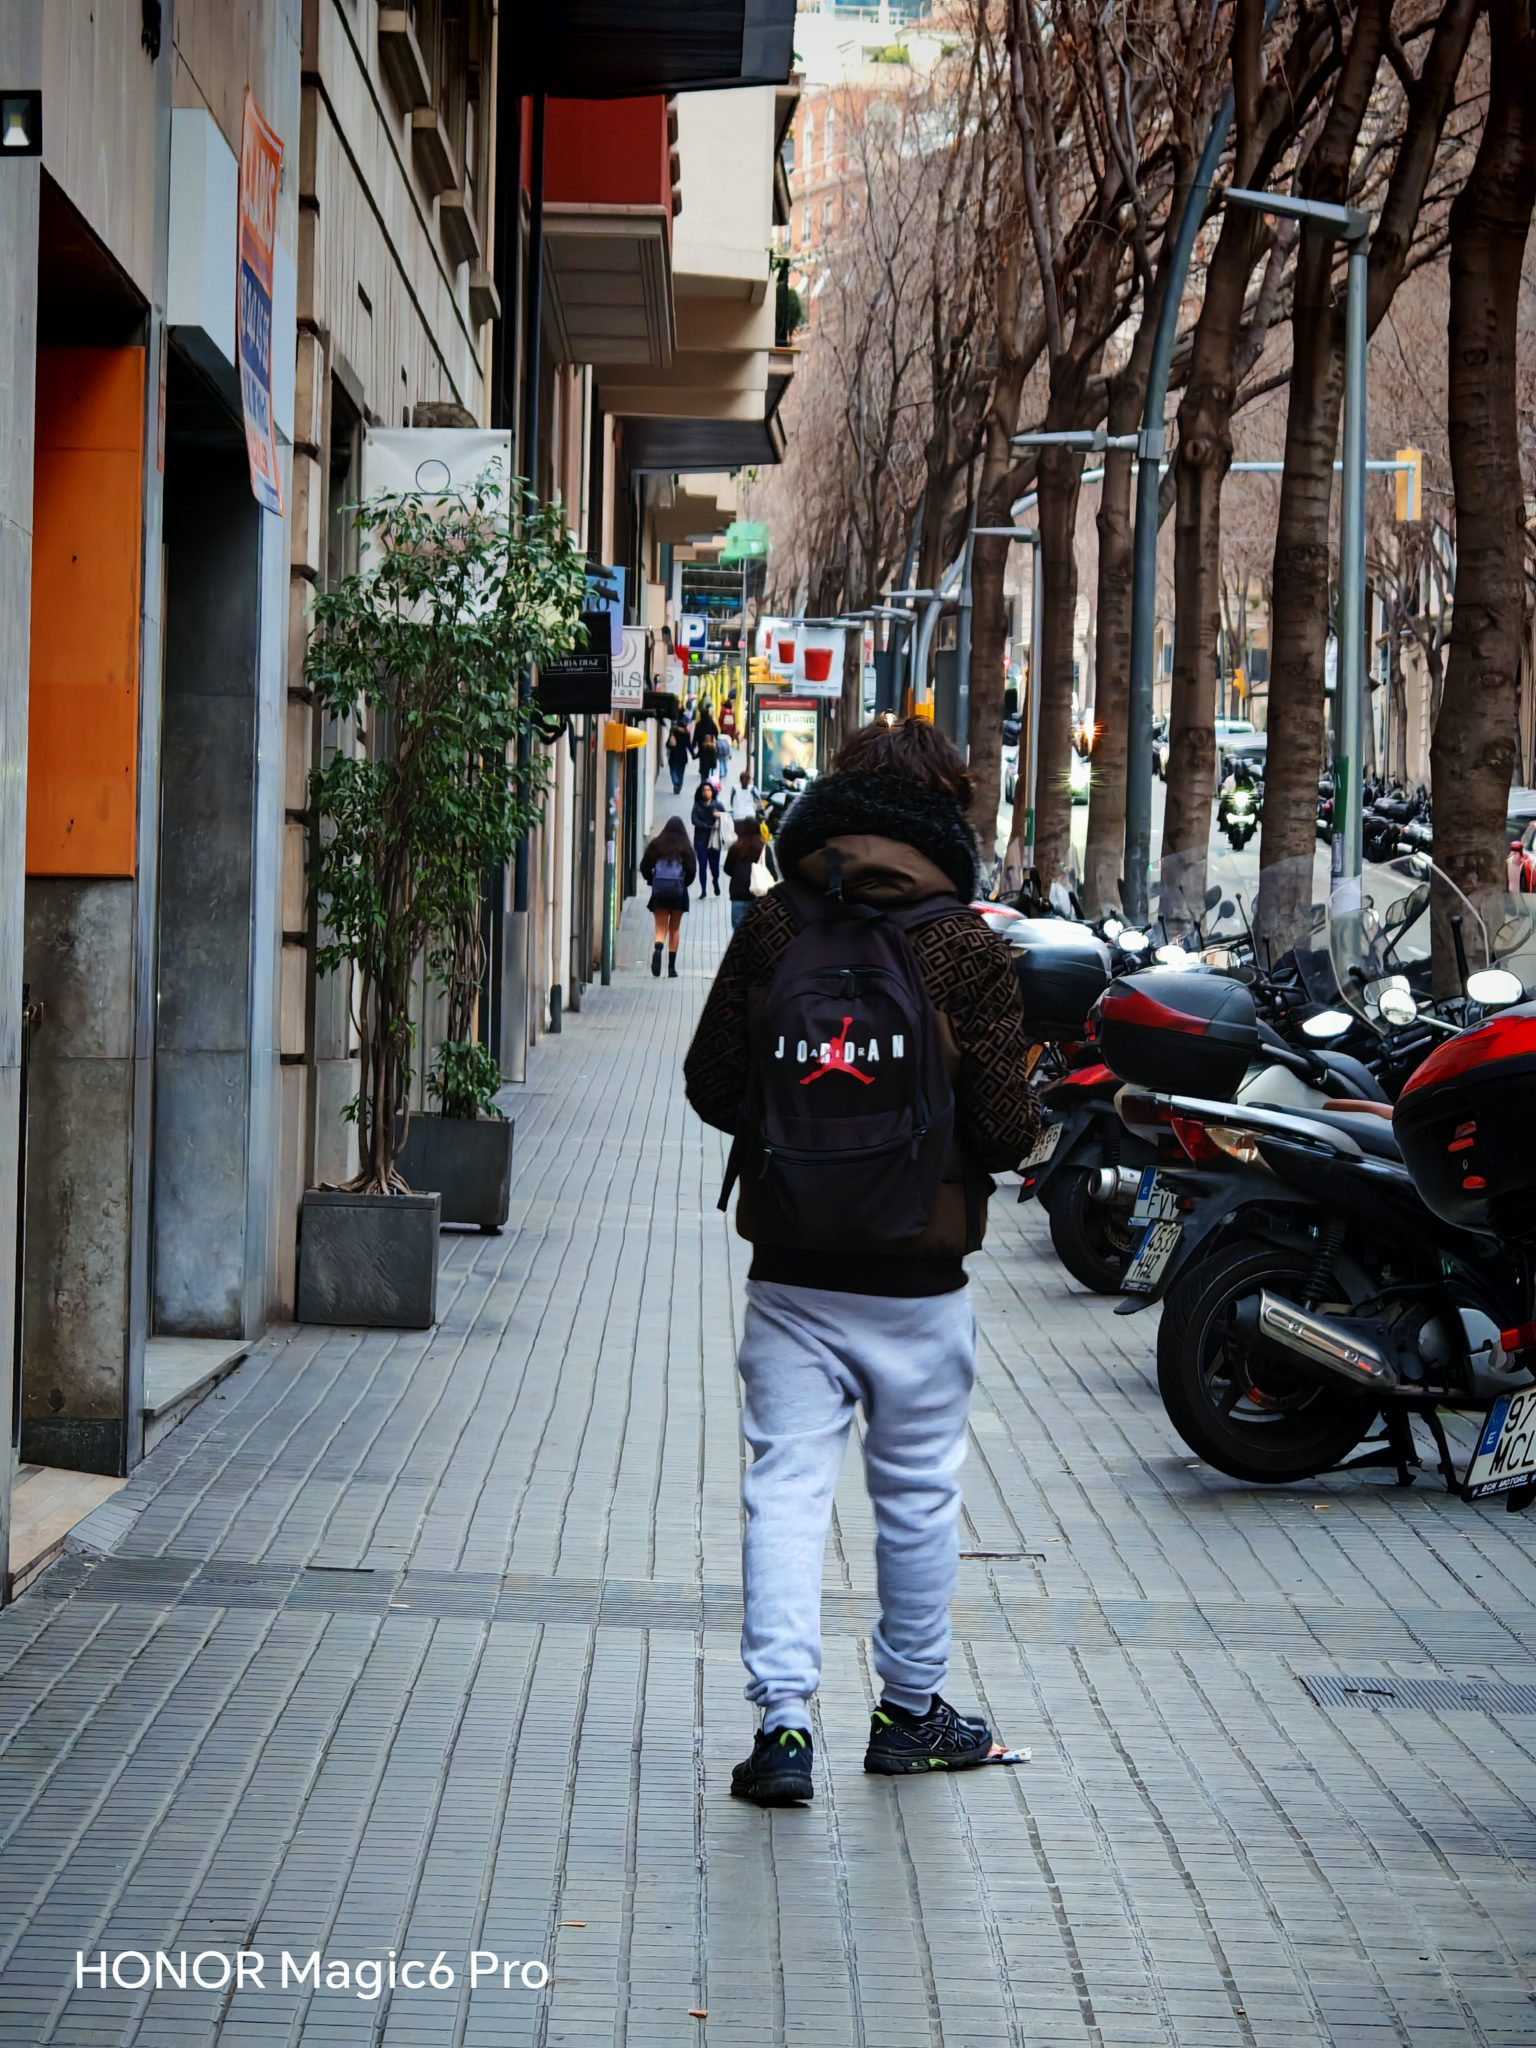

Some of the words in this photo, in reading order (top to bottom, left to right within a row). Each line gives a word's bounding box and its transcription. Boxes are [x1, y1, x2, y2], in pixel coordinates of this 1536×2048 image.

[682, 618, 705, 649] P
[774, 1034, 904, 1064] JORDAN
[1488, 1429, 1535, 1477] MCL
